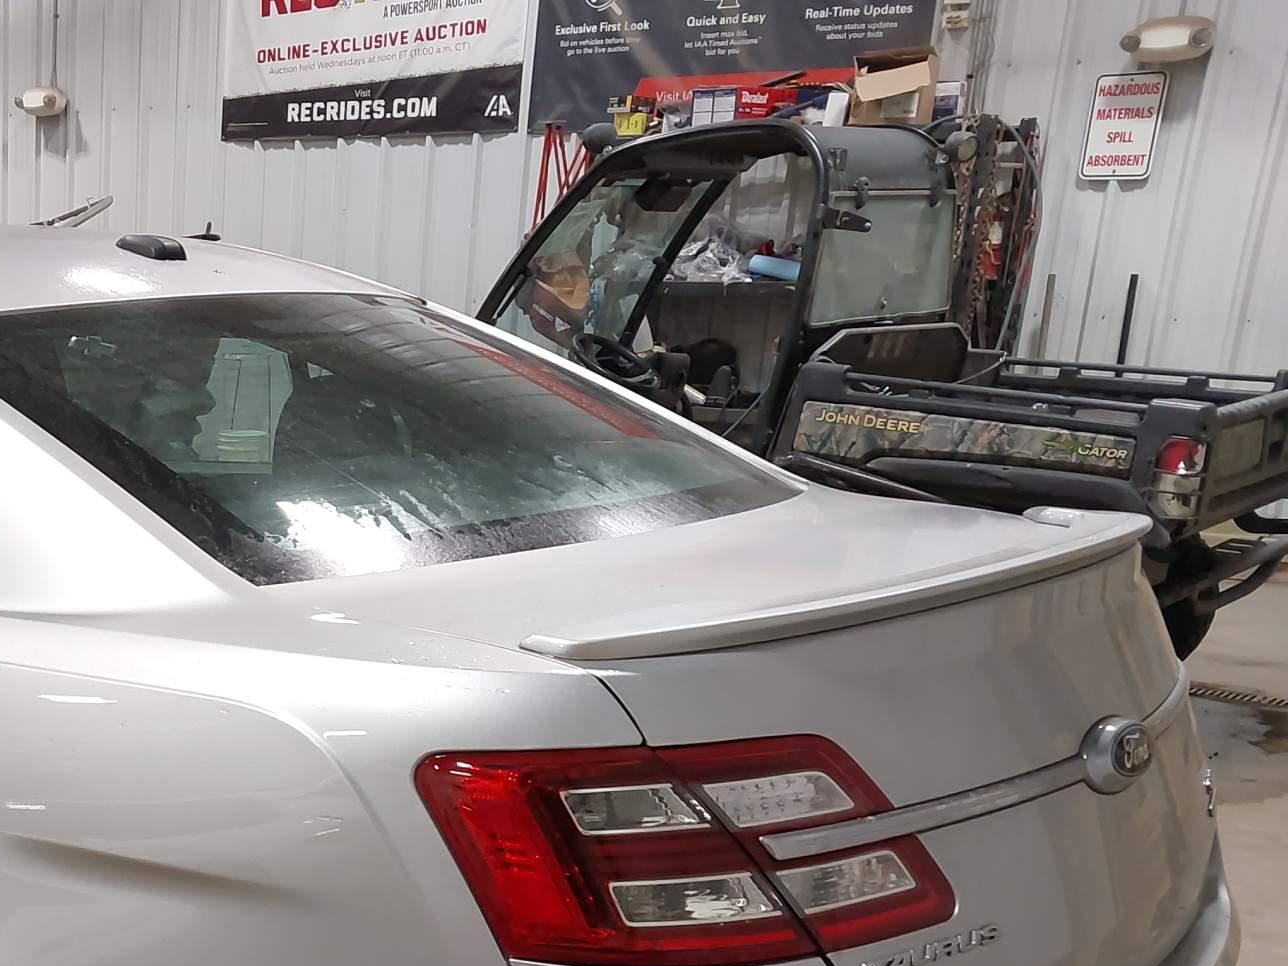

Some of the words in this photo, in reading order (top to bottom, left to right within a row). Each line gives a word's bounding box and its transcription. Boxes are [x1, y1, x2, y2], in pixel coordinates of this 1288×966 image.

[383, 6, 388, 18] A
[390, 0, 442, 17] POWERSPORT
[805, 6, 861, 19] Real-Time
[863, 4, 914, 18] Updates
[555, 23, 598, 36] Exclusive
[599, 21, 621, 32] First
[624, 19, 650, 31] Look
[686, 15, 717, 27] Quick
[719, 14, 739, 25] and
[742, 13, 766, 25] Easy
[867, 21, 898, 29] updates
[257, 30, 409, 64] ONLINE-EXCLUSIVE
[413, 18, 488, 43] AUCTION
[826, 32, 847, 40] about
[694, 40, 708, 48] IAA
[269, 64, 298, 76] Auction
[299, 63, 315, 73] held
[317, 58, 366, 71] Wednesdays
[368, 56, 376, 64] at
[377, 53, 397, 62] noon
[354, 88, 372, 98] Visit
[655, 90, 679, 102] Visit
[1098, 82, 1161, 97] HAZARDOUS
[287, 96, 438, 123] RECRIDES.COM
[1096, 106, 1154, 121] MATERIALS
[1106, 131, 1134, 144] SPILL
[1086, 154, 1147, 168] ABSORBENT
[815, 408, 860, 426] JOHN
[863, 414, 921, 434] DEERE
[1078, 443, 1129, 461] GATOR
